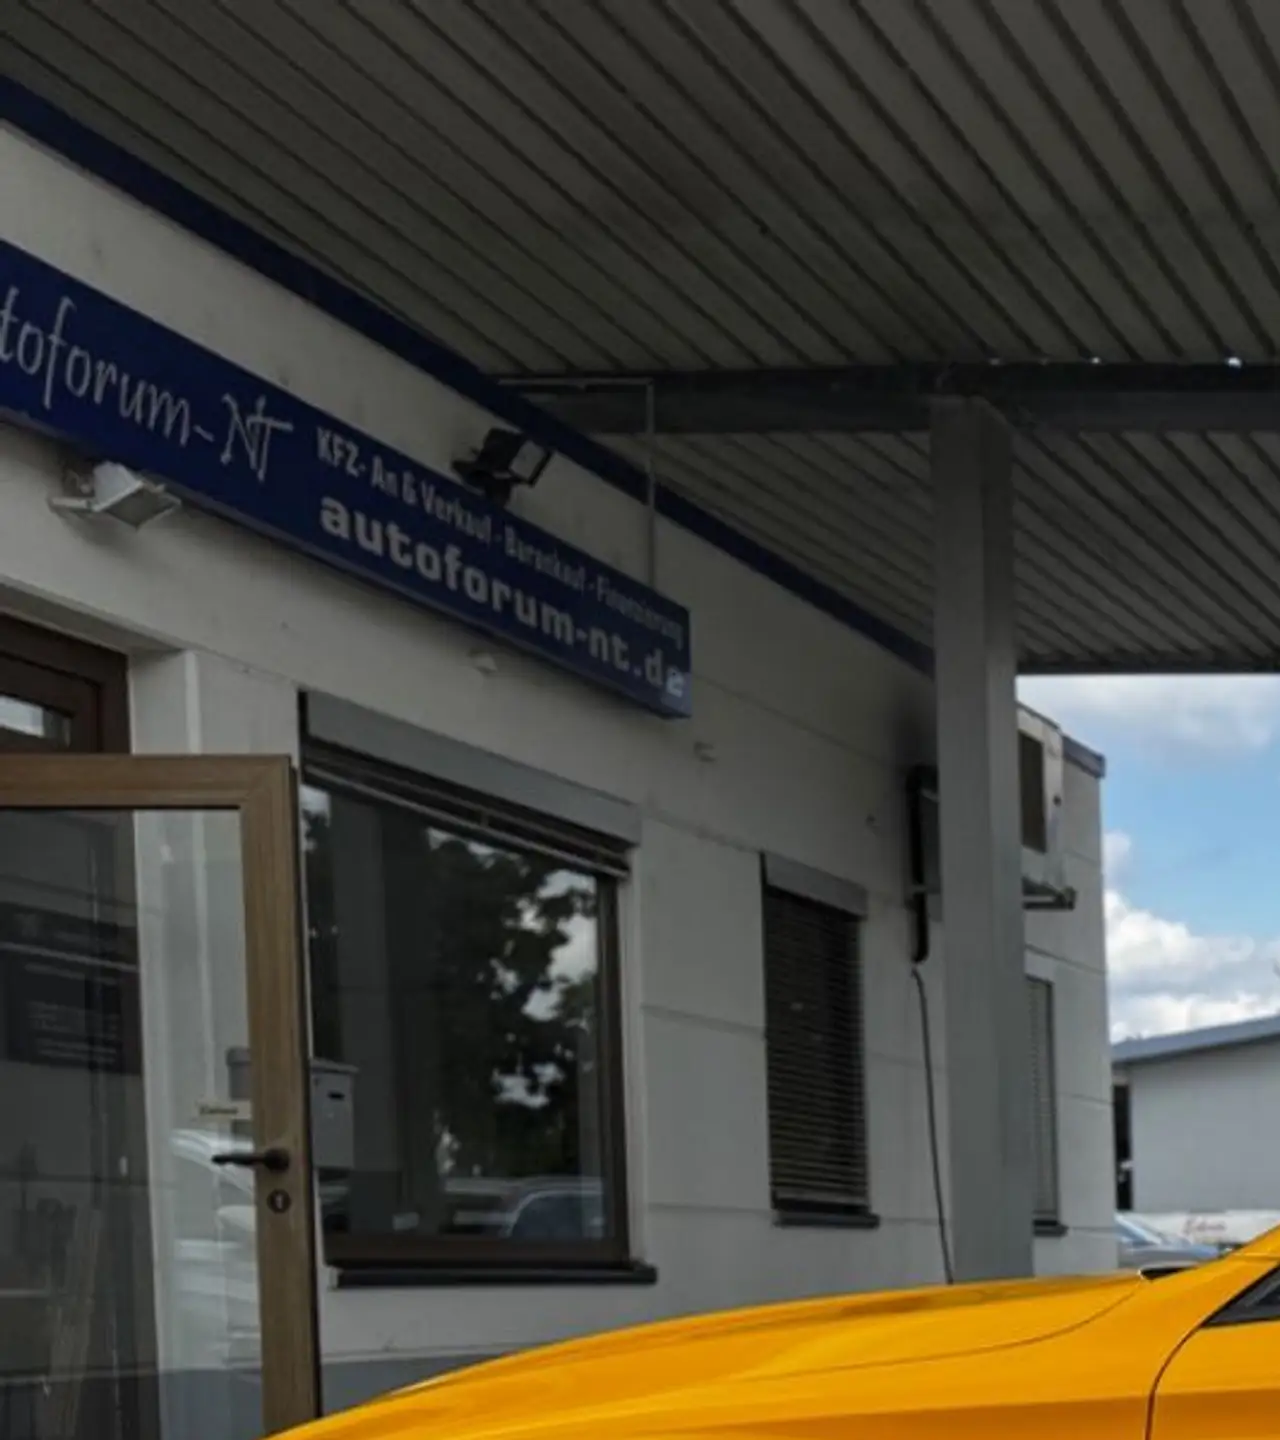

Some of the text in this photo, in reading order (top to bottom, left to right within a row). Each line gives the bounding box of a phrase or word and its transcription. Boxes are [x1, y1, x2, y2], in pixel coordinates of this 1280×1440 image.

[370, 453, 398, 498] An
[421, 480, 492, 547] Verkauf
[319, 496, 685, 699] autoforum-nt.de
